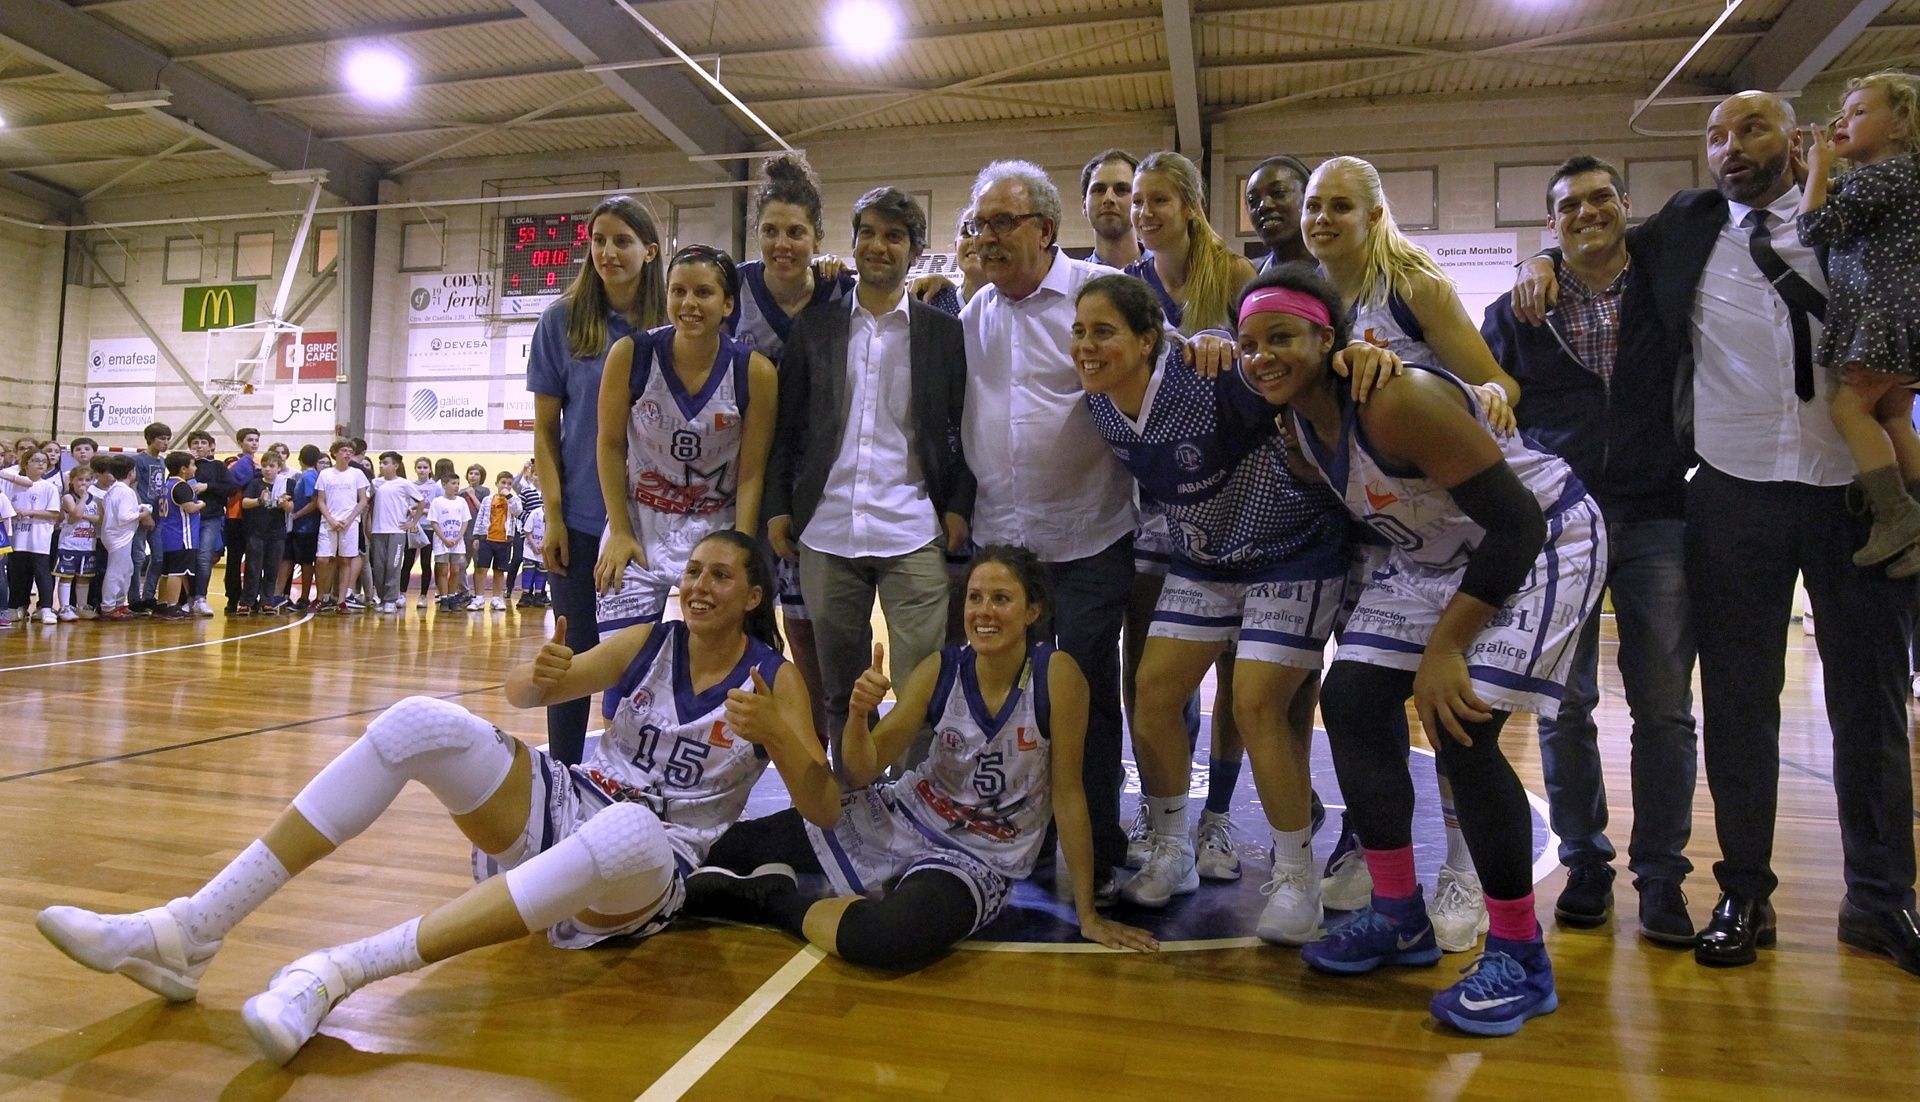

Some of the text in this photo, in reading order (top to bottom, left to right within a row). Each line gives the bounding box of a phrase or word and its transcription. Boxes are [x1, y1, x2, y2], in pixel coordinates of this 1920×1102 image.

[512, 217, 534, 225] LOCAL
[1437, 246, 1513, 258] Optica Montalbo
[443, 288, 492, 313] ferrol
[444, 340, 488, 349] DEVESA
[108, 352, 156, 366] emafesa
[306, 352, 337, 362] CAPEL
[109, 404, 153, 417] Deputación
[439, 408, 484, 418] calidade
[108, 413, 152, 425] DA CORUÑA
[670, 429, 701, 462] 8
[1178, 469, 1228, 495] ABANCA
[1474, 639, 1528, 660] galicia
[631, 724, 711, 789] 15
[972, 752, 1006, 800] 5
